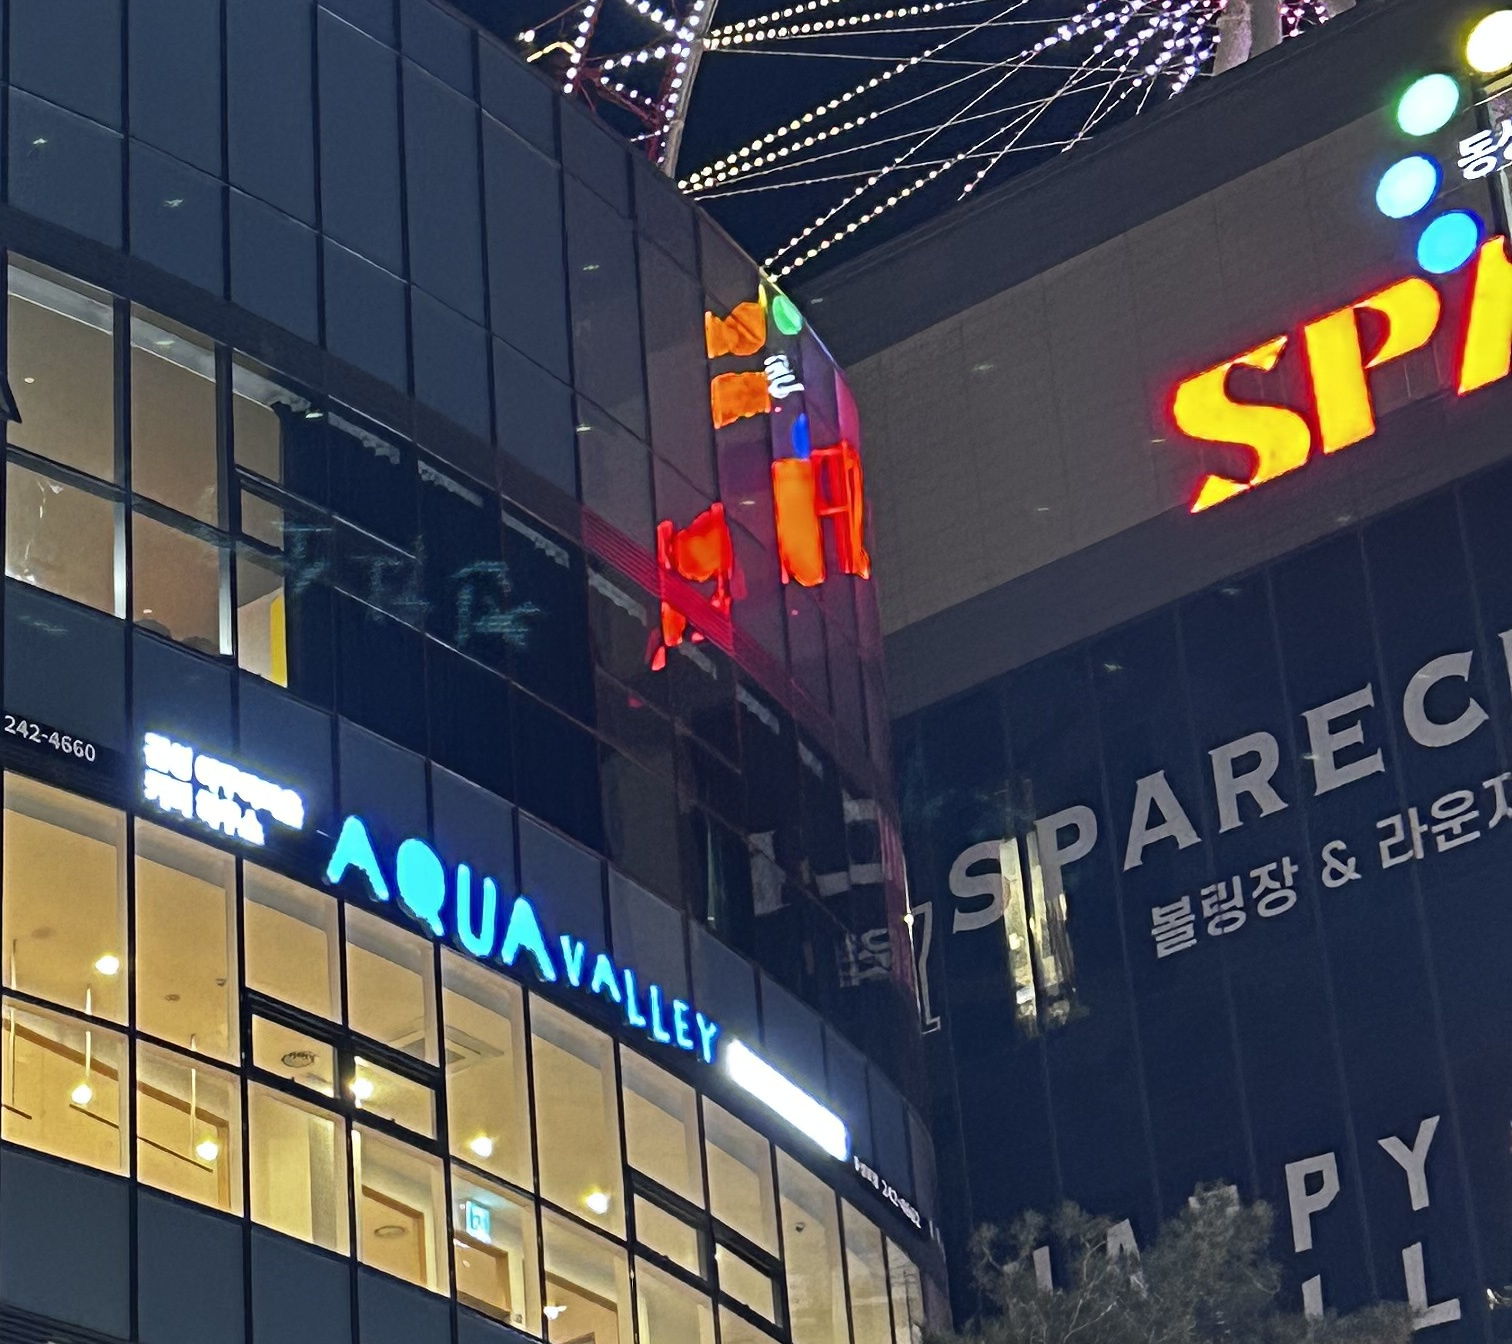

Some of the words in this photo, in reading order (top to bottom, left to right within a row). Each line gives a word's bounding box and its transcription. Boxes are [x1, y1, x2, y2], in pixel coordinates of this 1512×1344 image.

[4, 715, 96, 762] 242-4660
[948, 629, 1512, 935] SPAREC
[326, 815, 557, 983] AQUA
[559, 934, 720, 1064] VALLEY
[1151, 857, 1299, 959] 볼링장
[1320, 840, 1362, 888] &
